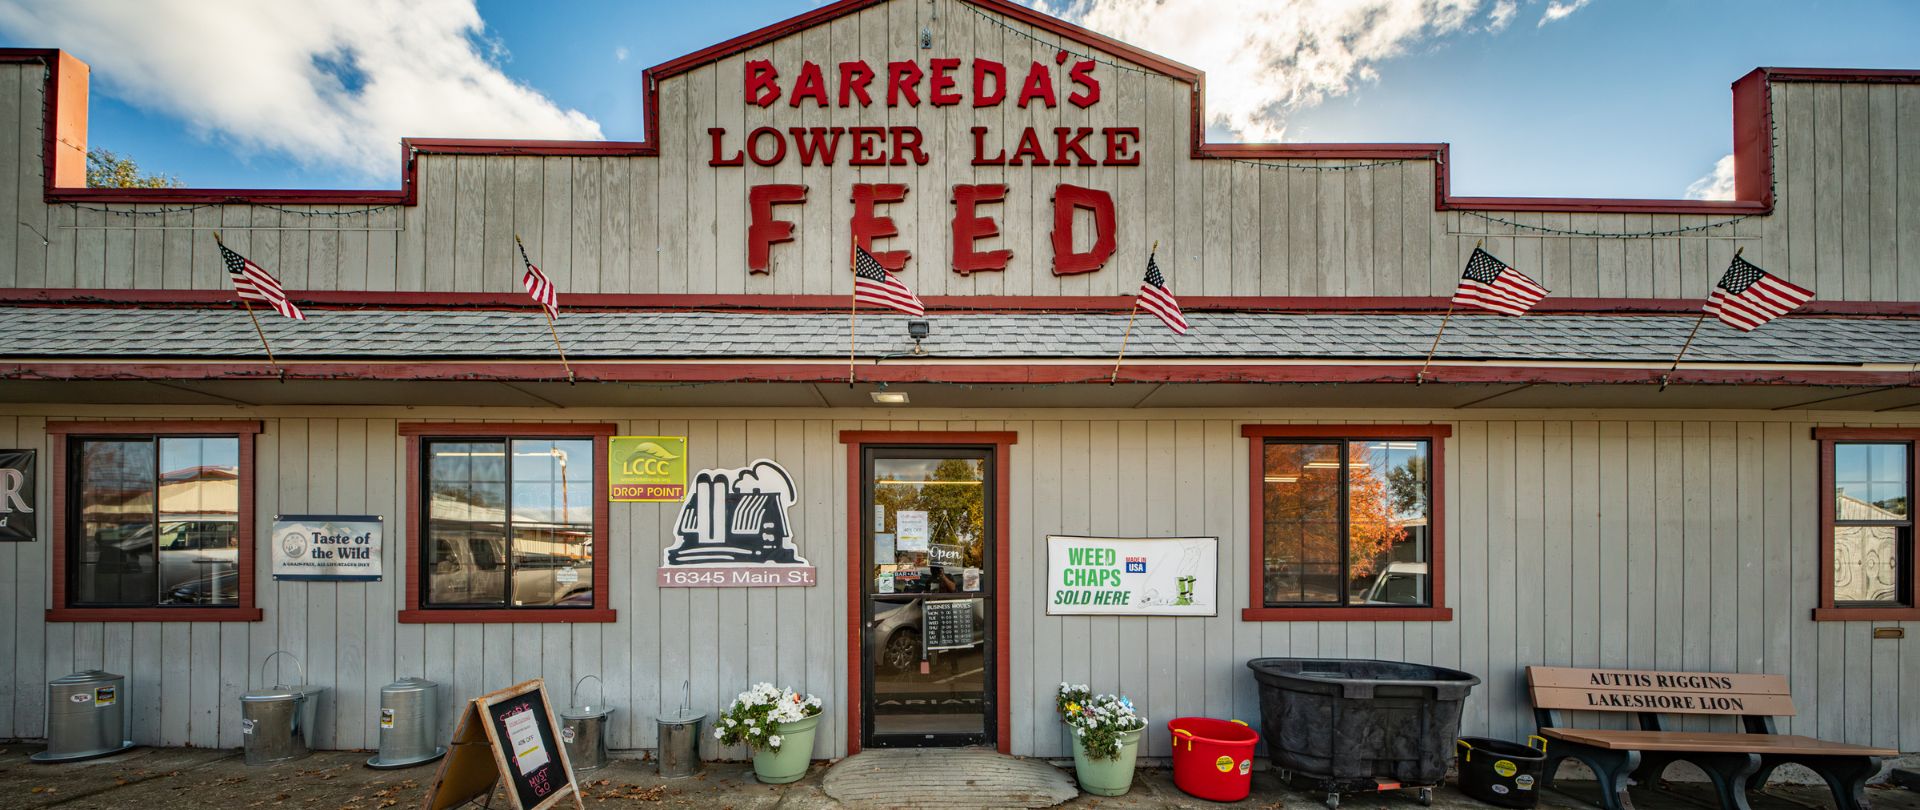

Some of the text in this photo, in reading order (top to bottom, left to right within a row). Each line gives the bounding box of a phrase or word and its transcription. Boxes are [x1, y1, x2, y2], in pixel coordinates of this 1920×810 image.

[745, 50, 1101, 108] BARREDA'S
[708, 126, 1141, 167] LOWER LAKE
[748, 183, 1117, 276] FEED
[623, 458, 670, 475] LCCC
[613, 487, 682, 497] DROP POINT
[311, 532, 371, 545] Taste of
[311, 547, 370, 559] the Wild
[930, 546, 962, 561] Open
[1068, 547, 1116, 567] WEED
[1128, 563, 1144, 572] USA
[663, 570, 814, 583] 16345 Main St.
[1063, 568, 1121, 587] CHAPS
[1054, 590, 1131, 605] SOLD HERE
[1590, 672, 1732, 690] AUTTIS RIGGINS
[1586, 692, 1745, 711] LAKESHORE LION
[528, 767, 548, 788] MUST
[535, 782, 551, 796] GO
